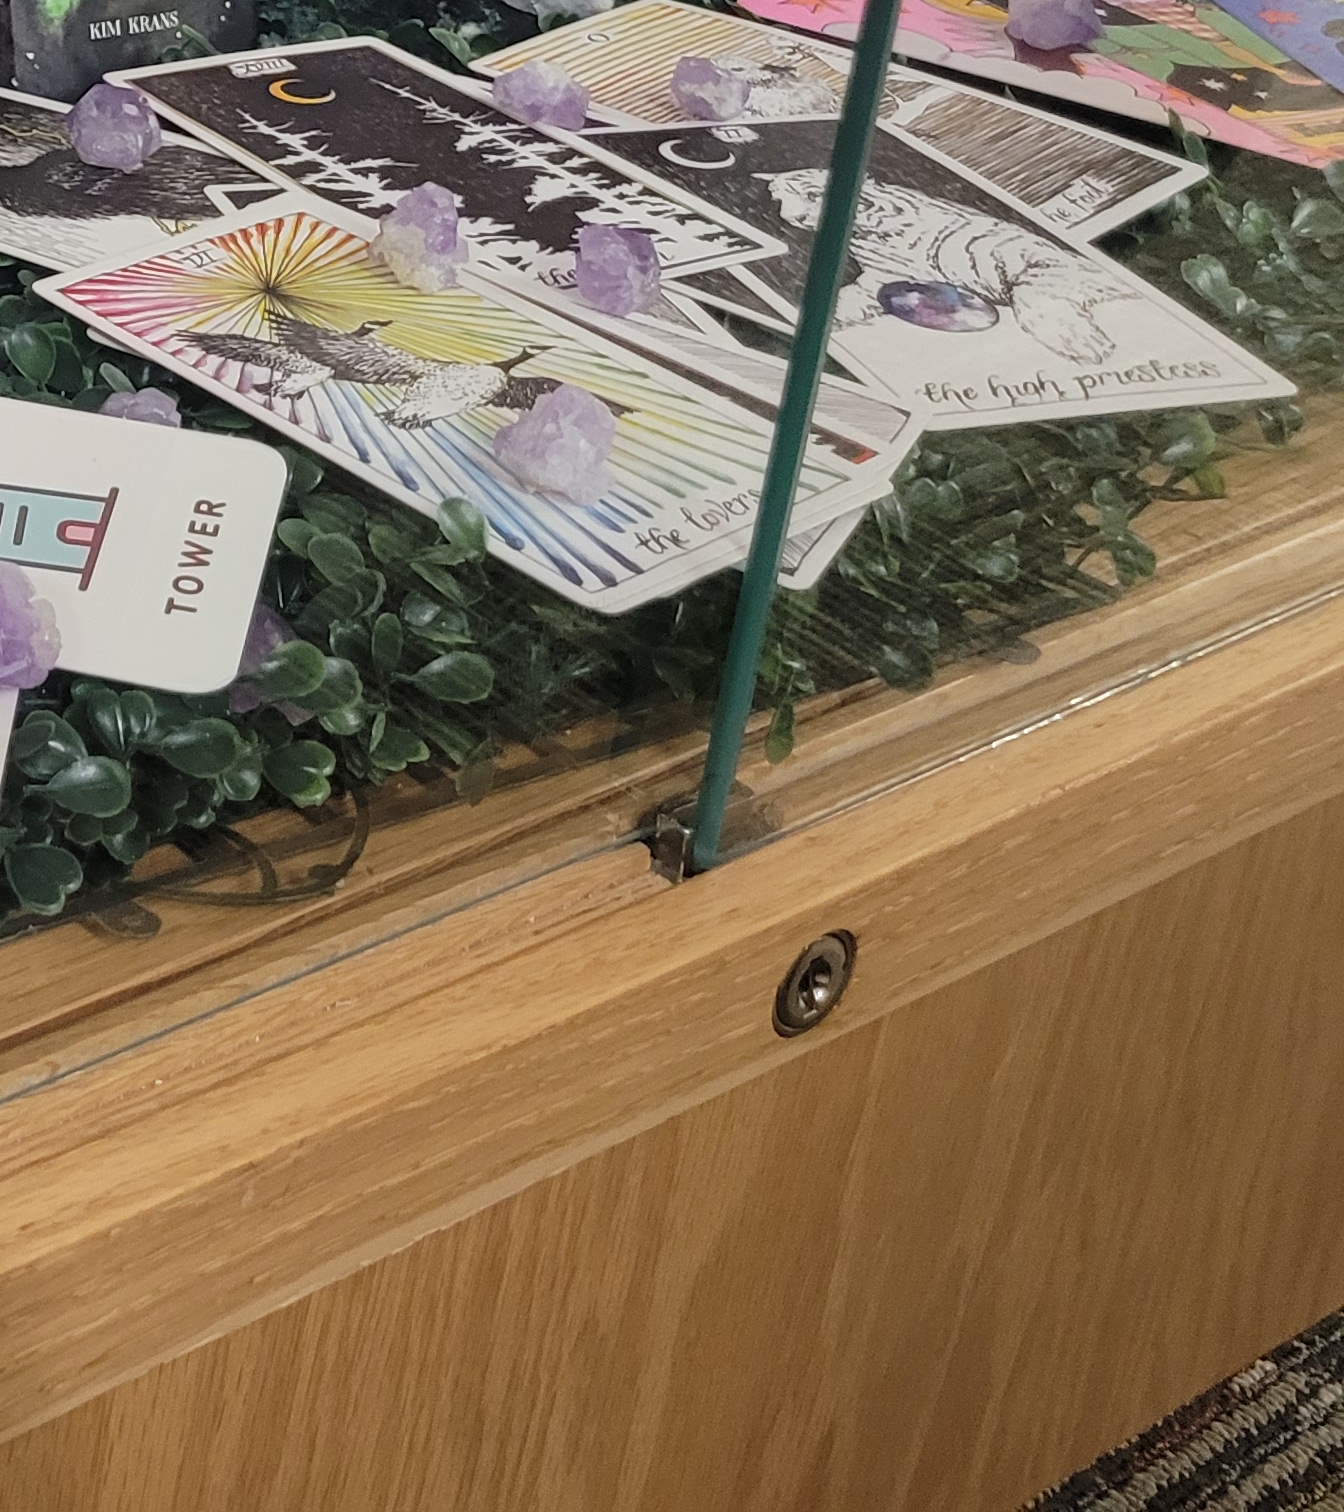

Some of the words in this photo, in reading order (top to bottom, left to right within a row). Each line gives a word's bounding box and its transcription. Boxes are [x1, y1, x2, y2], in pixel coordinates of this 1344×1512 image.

[89, 19, 124, 40] KIM
[128, 10, 179, 36] KRANS
[915, 381, 977, 409] the
[988, 370, 1065, 407] high
[1072, 359, 1221, 400] priestess
[165, 499, 227, 616] TOWER
[634, 528, 689, 554] the
